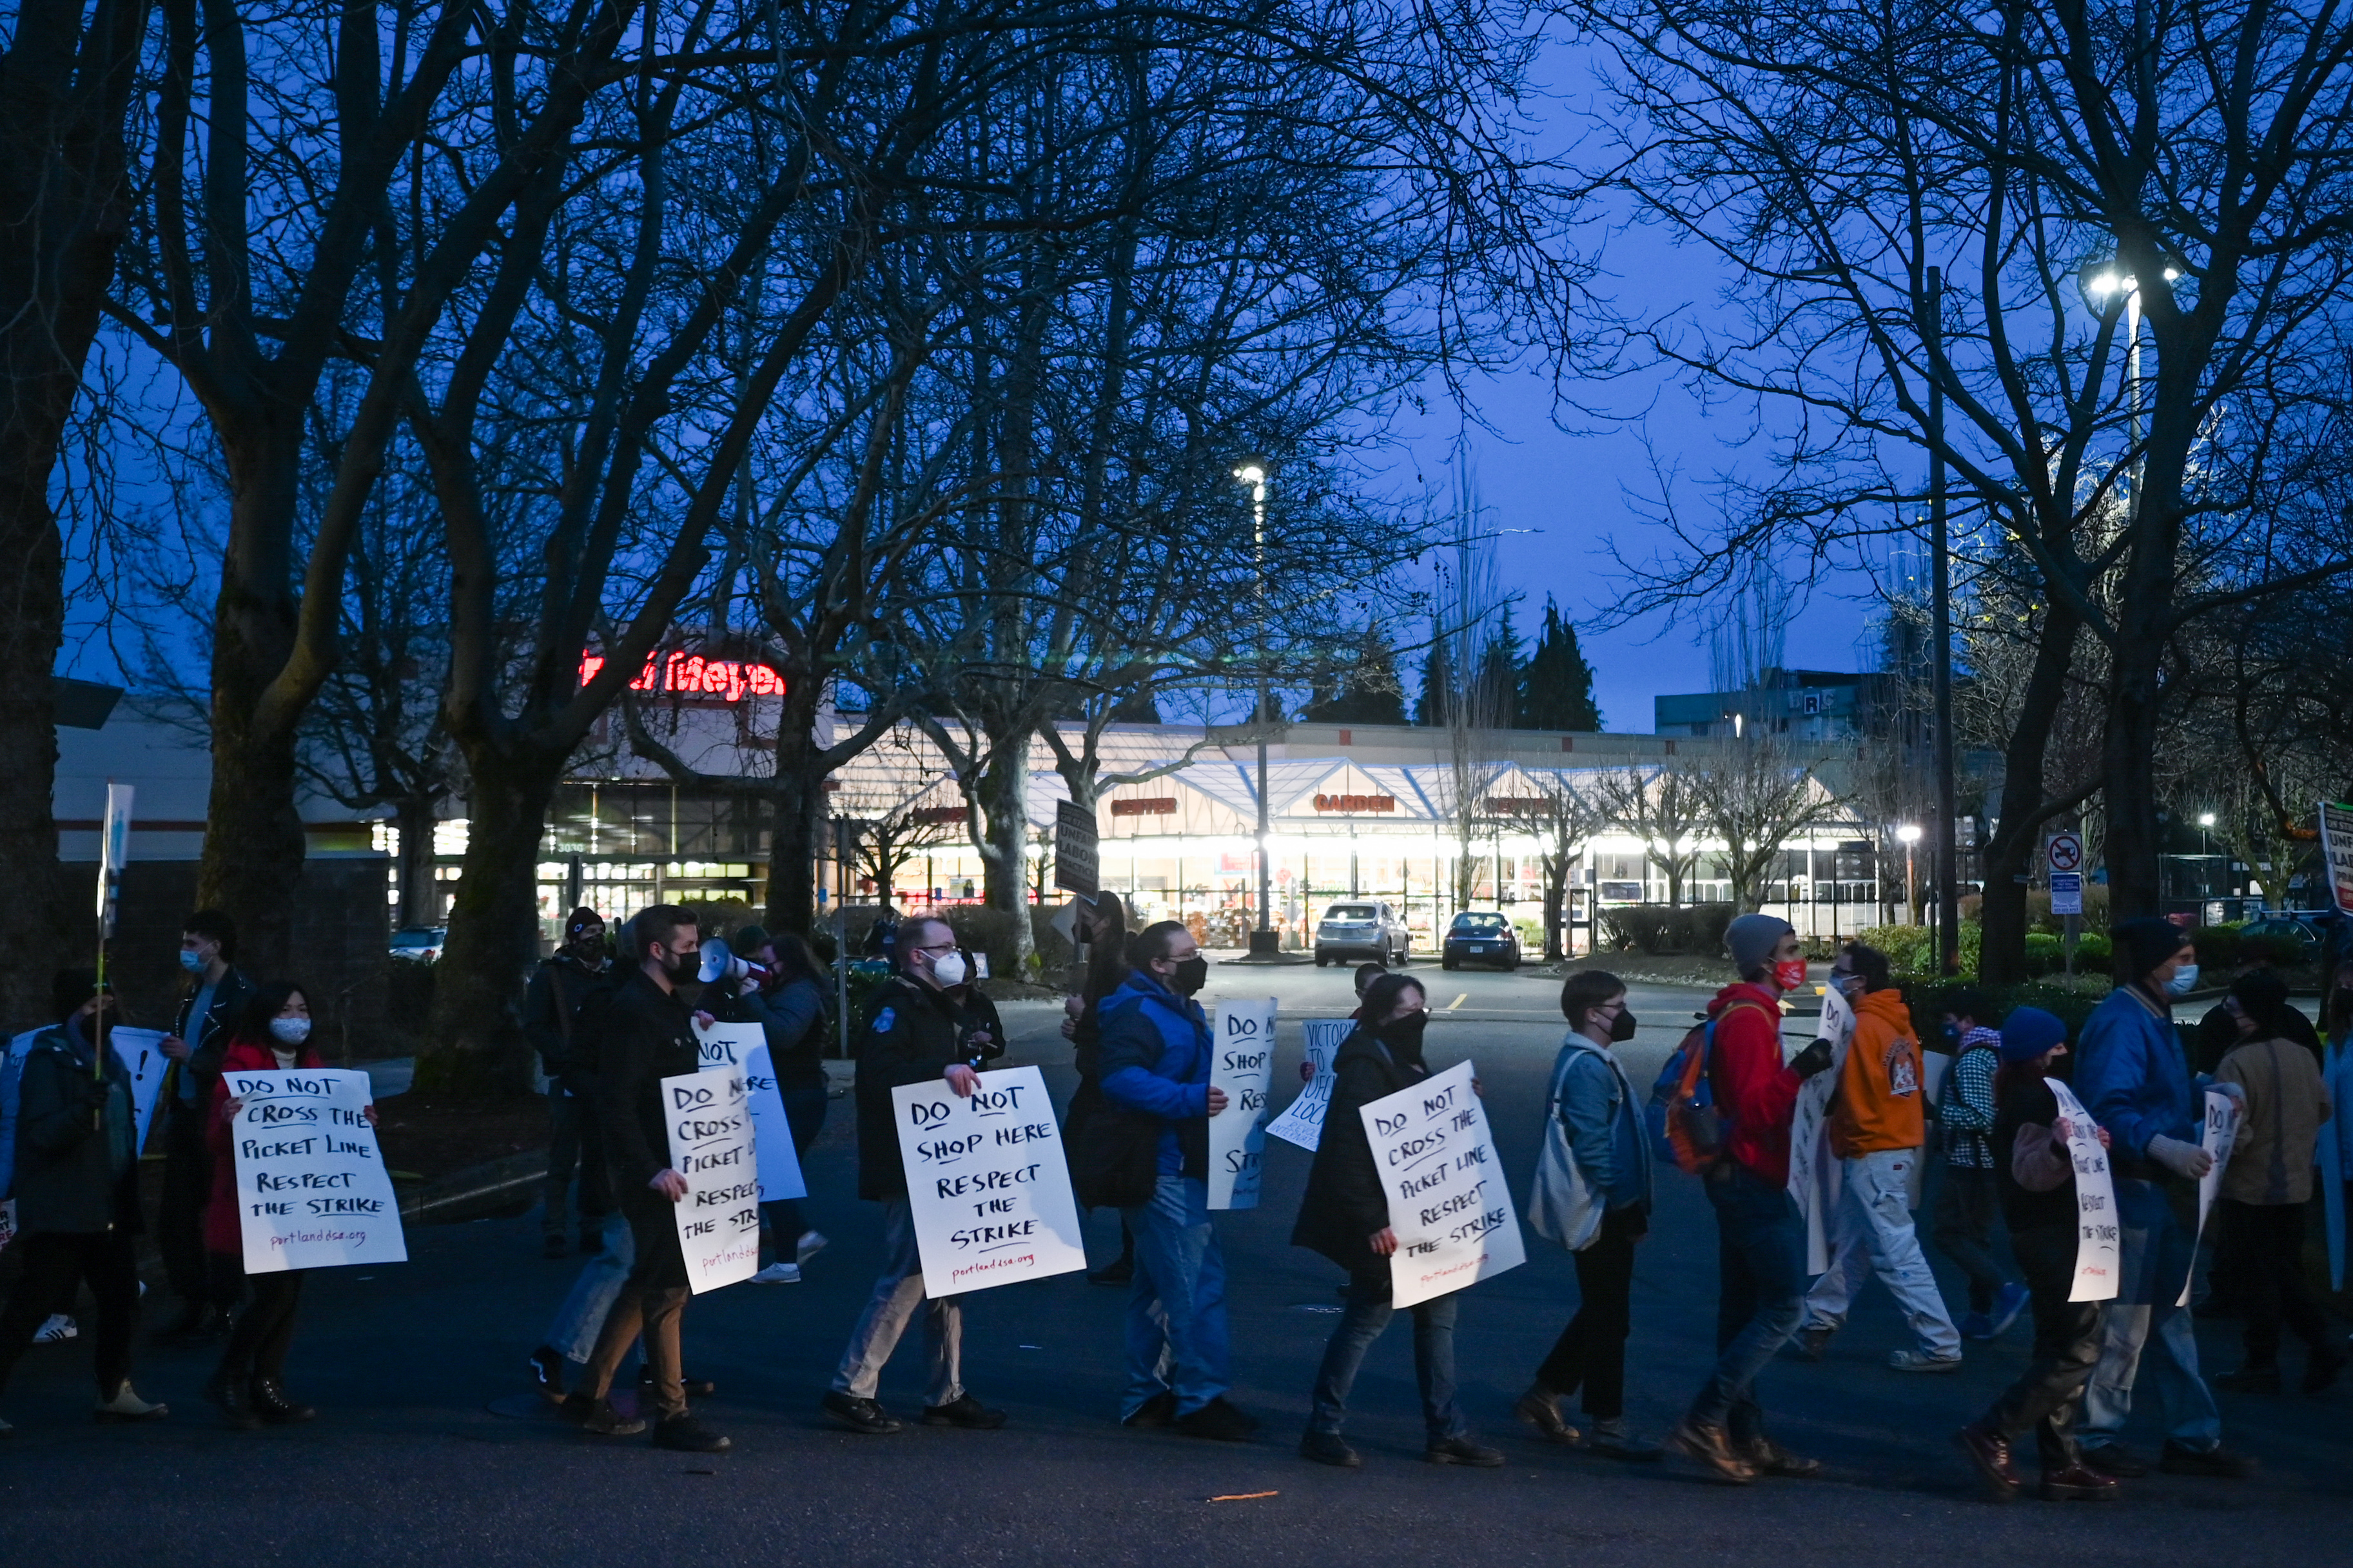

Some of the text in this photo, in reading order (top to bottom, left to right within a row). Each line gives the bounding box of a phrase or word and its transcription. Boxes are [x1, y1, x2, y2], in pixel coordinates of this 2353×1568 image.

[1313, 794, 1394, 813] GARDEN
[558, 842, 584, 853] 3030
[1227, 1014, 1257, 1036] DO
[1222, 1050, 1266, 1071] SHOP
[1309, 1048, 1325, 1072] TO
[237, 1078, 341, 1095] DO NOT
[674, 1087, 713, 1110] DO
[248, 1105, 370, 1128] CROSS THE
[912, 1086, 1024, 1125] DO NOT
[1375, 1085, 1456, 1137] DO NOT
[678, 1115, 741, 1141] CROSS
[1389, 1108, 1477, 1166] CROSS THE
[242, 1134, 371, 1159] PICKET LINE
[917, 1123, 1052, 1163] SHOP HERE
[683, 1147, 743, 1174] PICKET
[1400, 1144, 1488, 1199] PICKET LINE
[257, 1172, 356, 1193] RESPECT
[936, 1164, 1041, 1199] RESPECT
[250, 1198, 385, 1217] THE STRIKE
[973, 1197, 1017, 1217] THE
[1420, 1180, 1487, 1226] RESPECT
[683, 1219, 716, 1239] THE
[950, 1219, 1039, 1250] STRIKE
[1407, 1207, 1506, 1258] THE STRIKE
